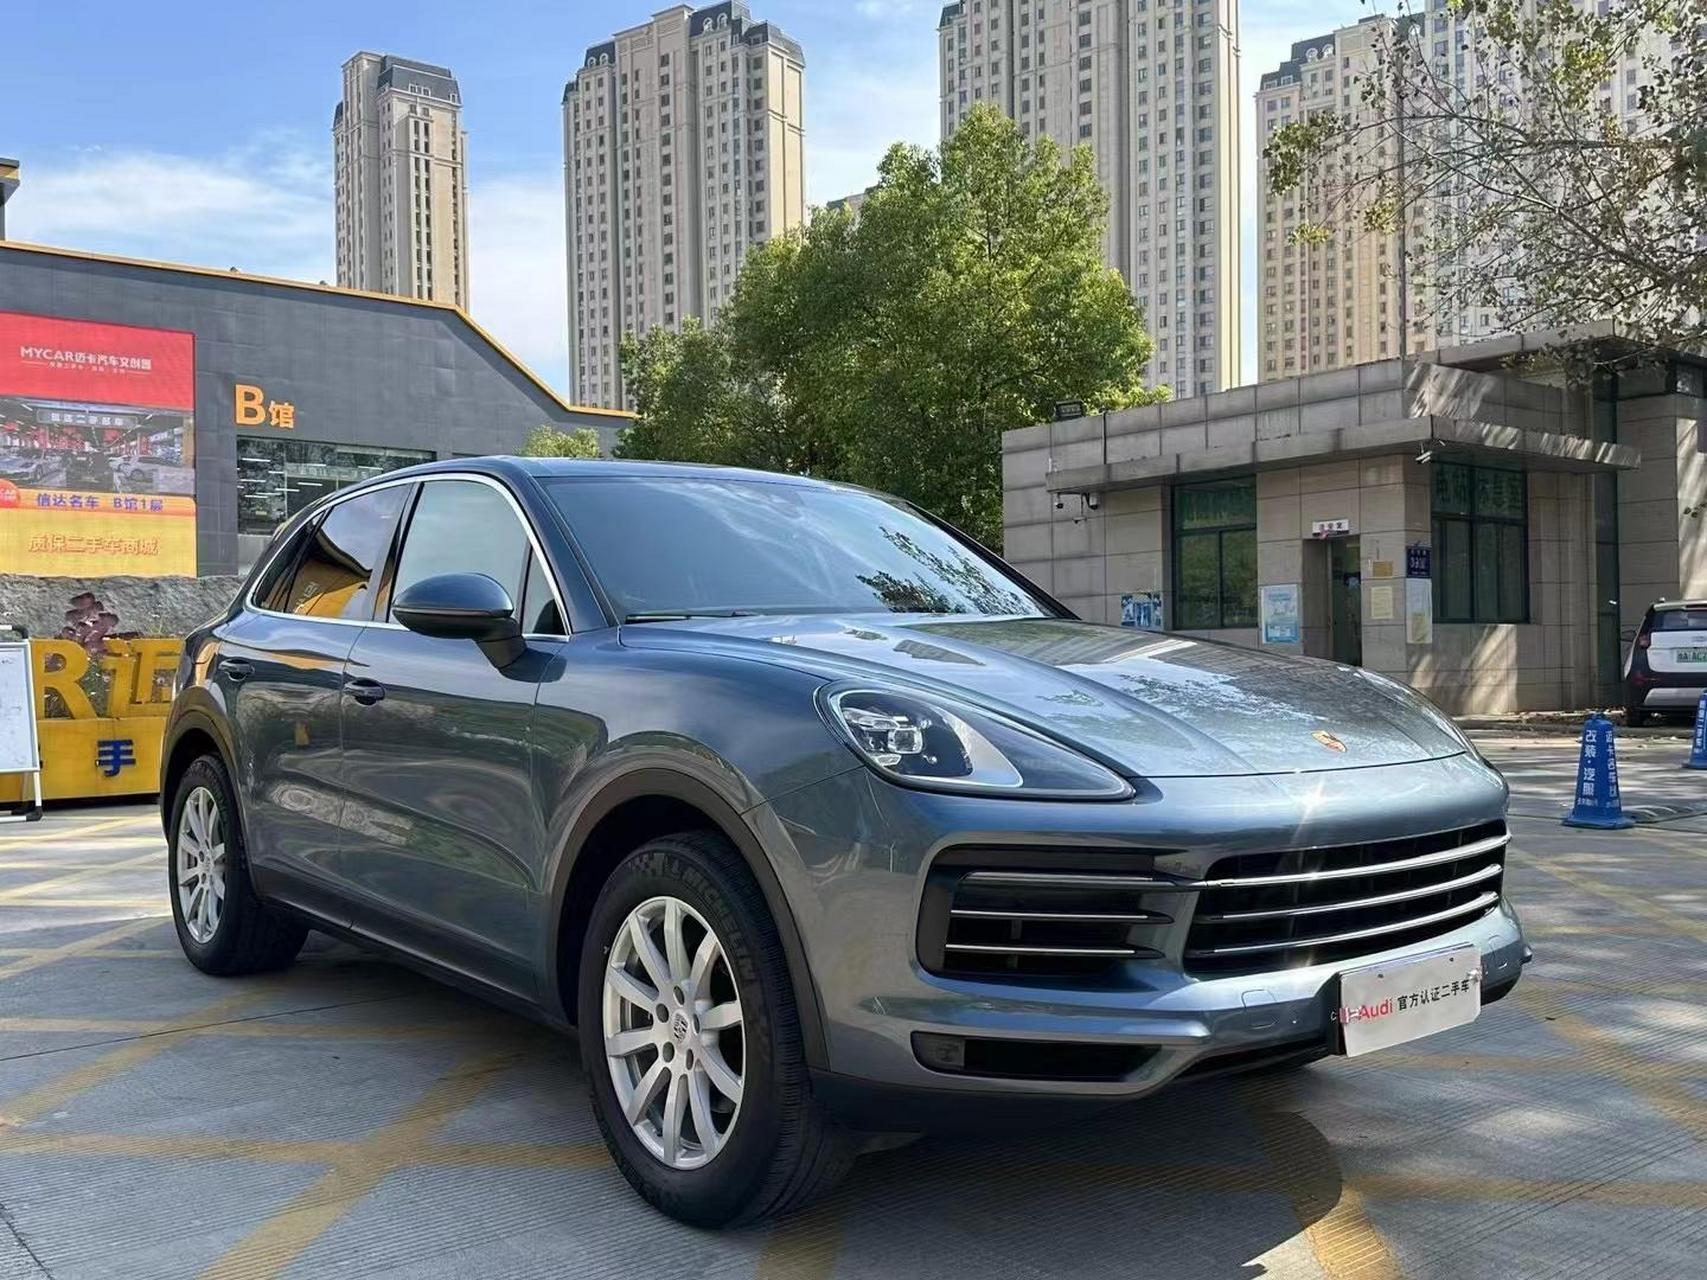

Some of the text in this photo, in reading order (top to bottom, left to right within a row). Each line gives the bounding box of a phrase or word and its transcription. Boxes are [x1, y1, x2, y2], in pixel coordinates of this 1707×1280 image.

[235, 383, 294, 429] B馆
[37, 493, 163, 512] 信达名车 B馆1层
[96, 739, 136, 777] 手
[1359, 979, 1470, 1019] Audi 官方认证二手车
